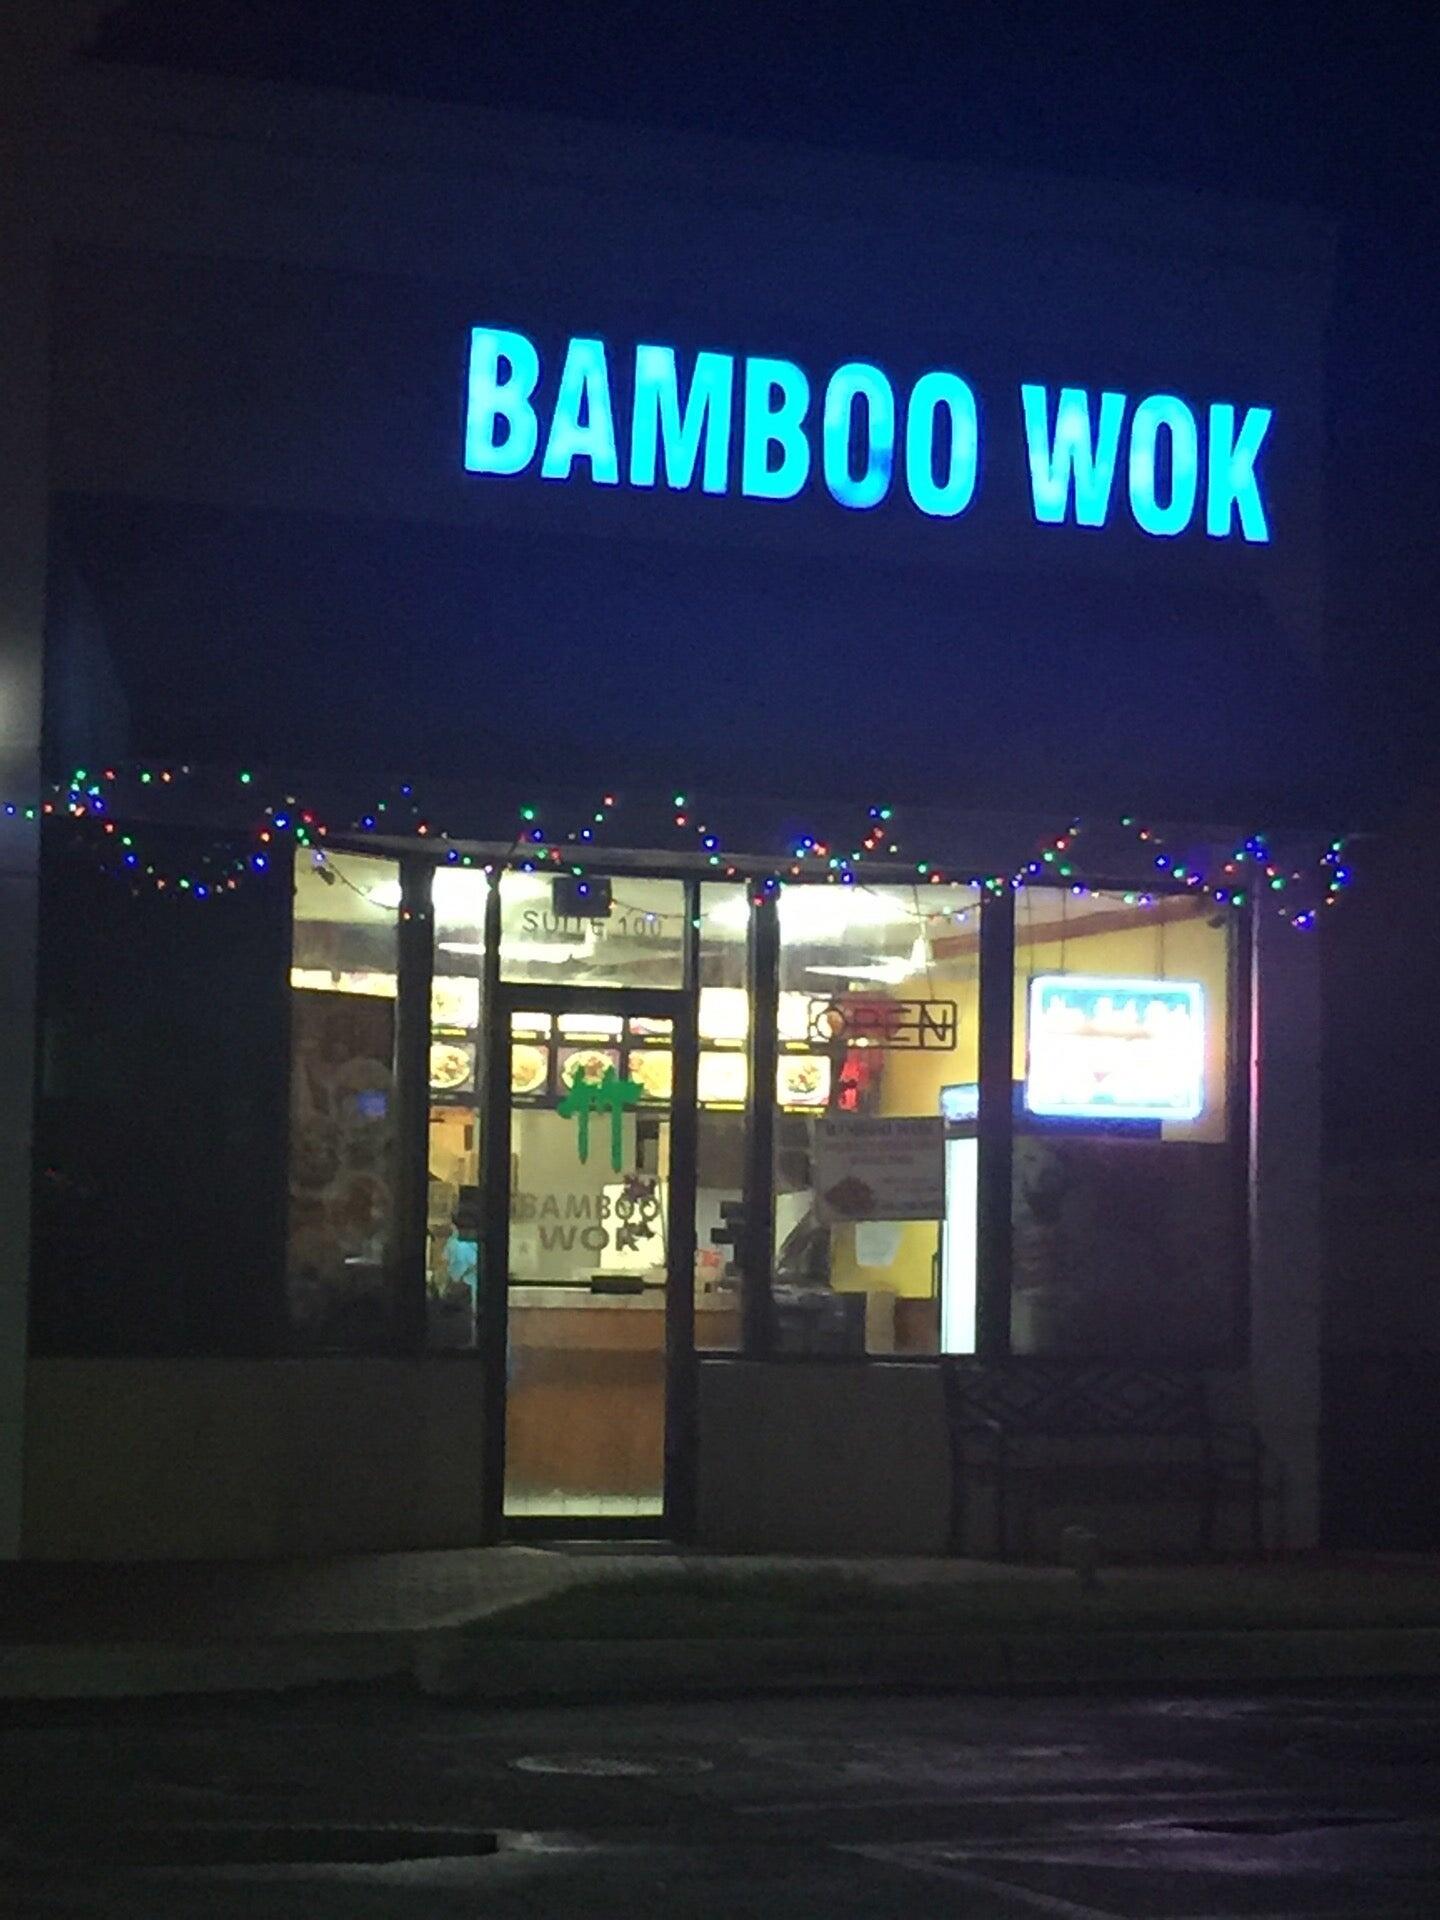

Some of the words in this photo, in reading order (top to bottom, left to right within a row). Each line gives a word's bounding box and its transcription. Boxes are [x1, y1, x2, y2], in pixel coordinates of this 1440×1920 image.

[464, 327, 978, 517] BAMBOO
[1020, 383, 1272, 542] WOK
[618, 915, 662, 937] 100
[816, 1007, 948, 1042] OPEN
[510, 1192, 661, 1221] BAMBOO
[538, 1225, 640, 1252] WOK
